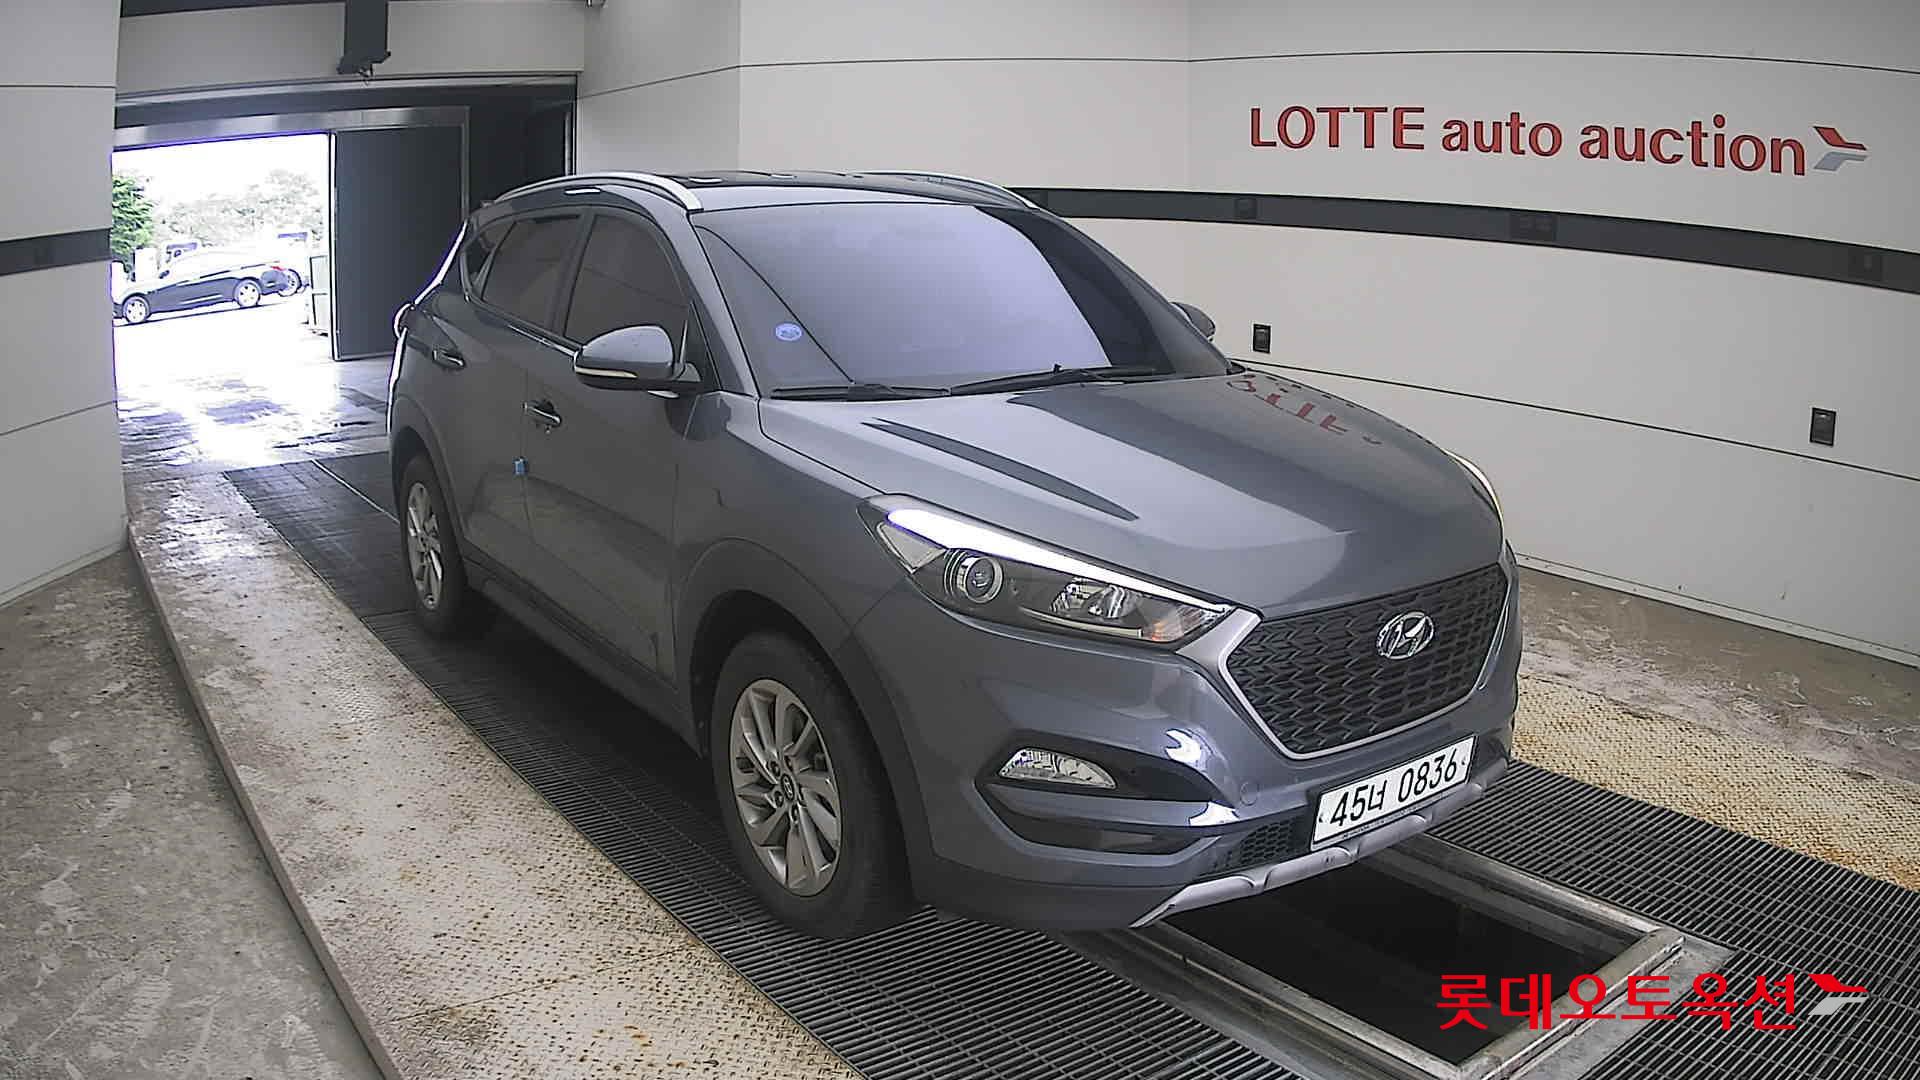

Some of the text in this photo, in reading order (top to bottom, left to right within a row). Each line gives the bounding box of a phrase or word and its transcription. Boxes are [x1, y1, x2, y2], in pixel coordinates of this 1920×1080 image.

[1250, 106, 1807, 176] LOTTE auto auction
[1330, 780, 1388, 827] 45너
[1398, 748, 1458, 803] 0836
